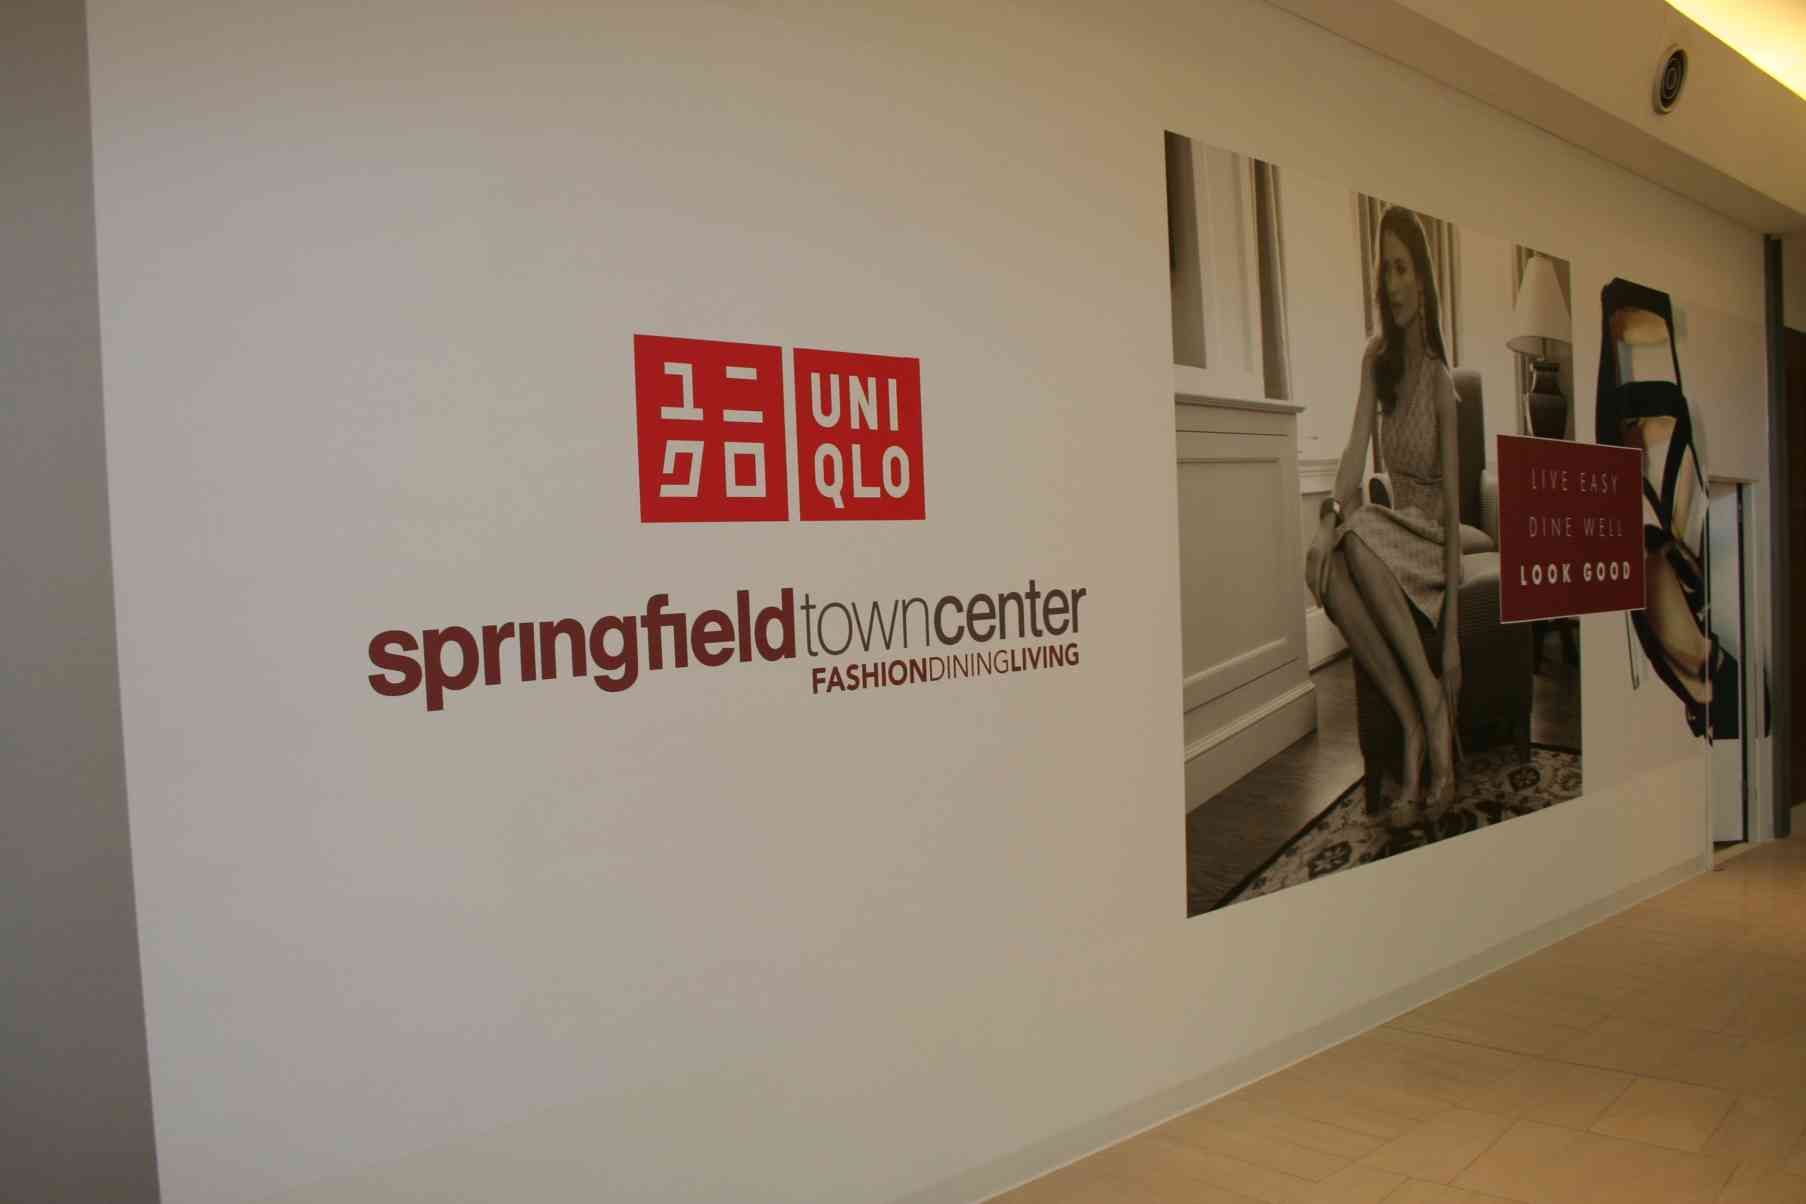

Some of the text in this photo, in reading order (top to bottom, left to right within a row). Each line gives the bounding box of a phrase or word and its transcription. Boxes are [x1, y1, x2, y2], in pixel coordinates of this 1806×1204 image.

[810, 371, 899, 432] UNI
[813, 442, 911, 509] QLO
[1531, 467, 1618, 493] LIVE EASY
[1529, 516, 1623, 538] DINE WELL
[1520, 561, 1631, 586] LOOK GOOD
